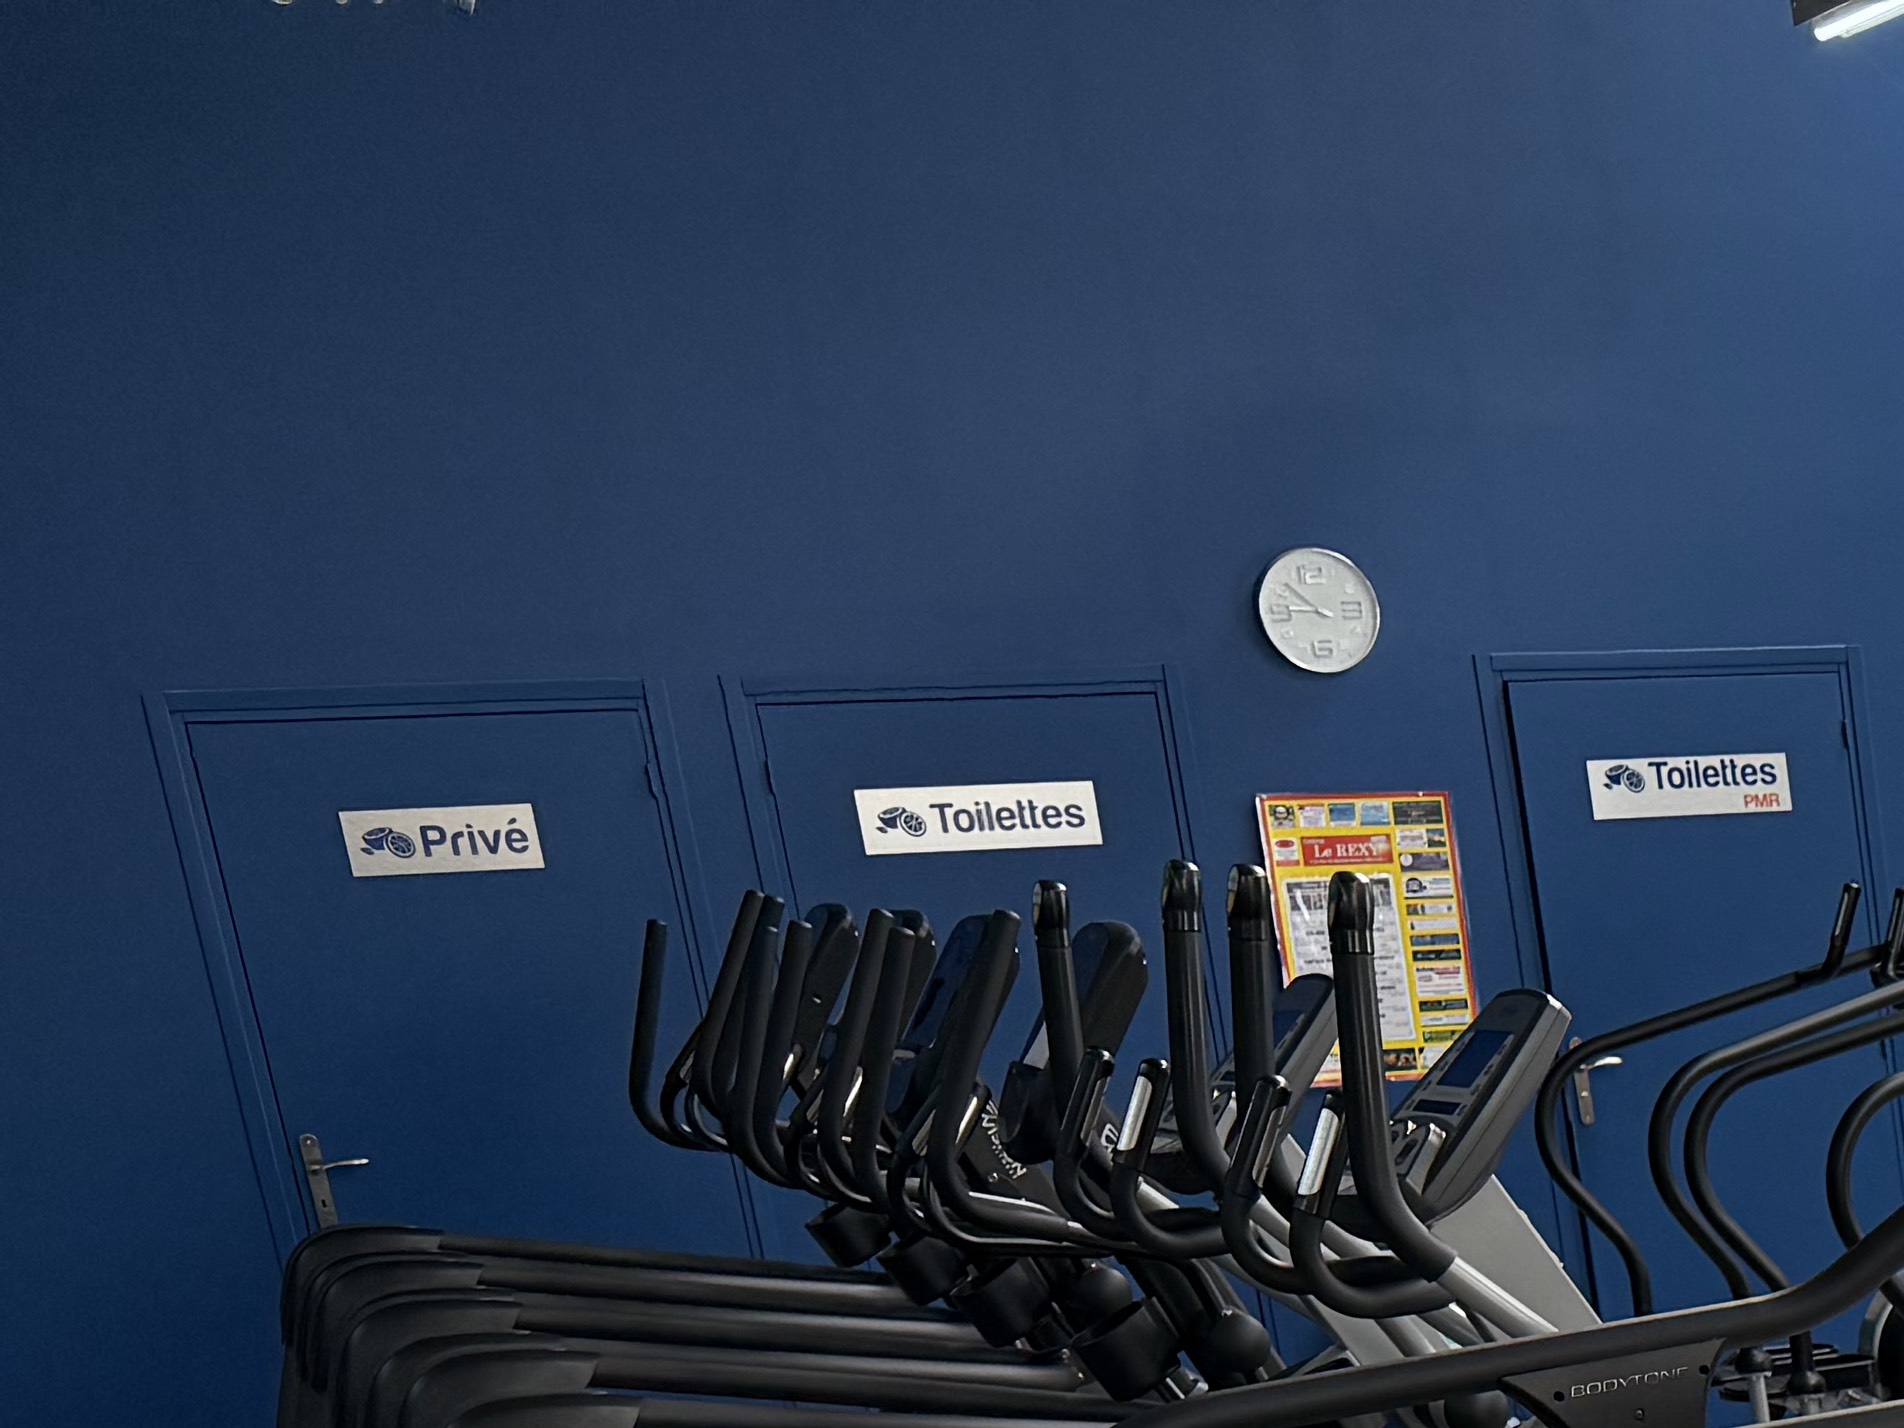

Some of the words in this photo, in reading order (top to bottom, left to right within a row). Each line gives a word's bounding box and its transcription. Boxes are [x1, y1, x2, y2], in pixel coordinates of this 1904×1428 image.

[1649, 758, 1777, 792] Toilettes
[929, 796, 1086, 837] Toilettes
[1744, 793, 1781, 811] PMR
[420, 815, 531, 860] Privé
[1570, 1366, 1690, 1398] BODYTONE
